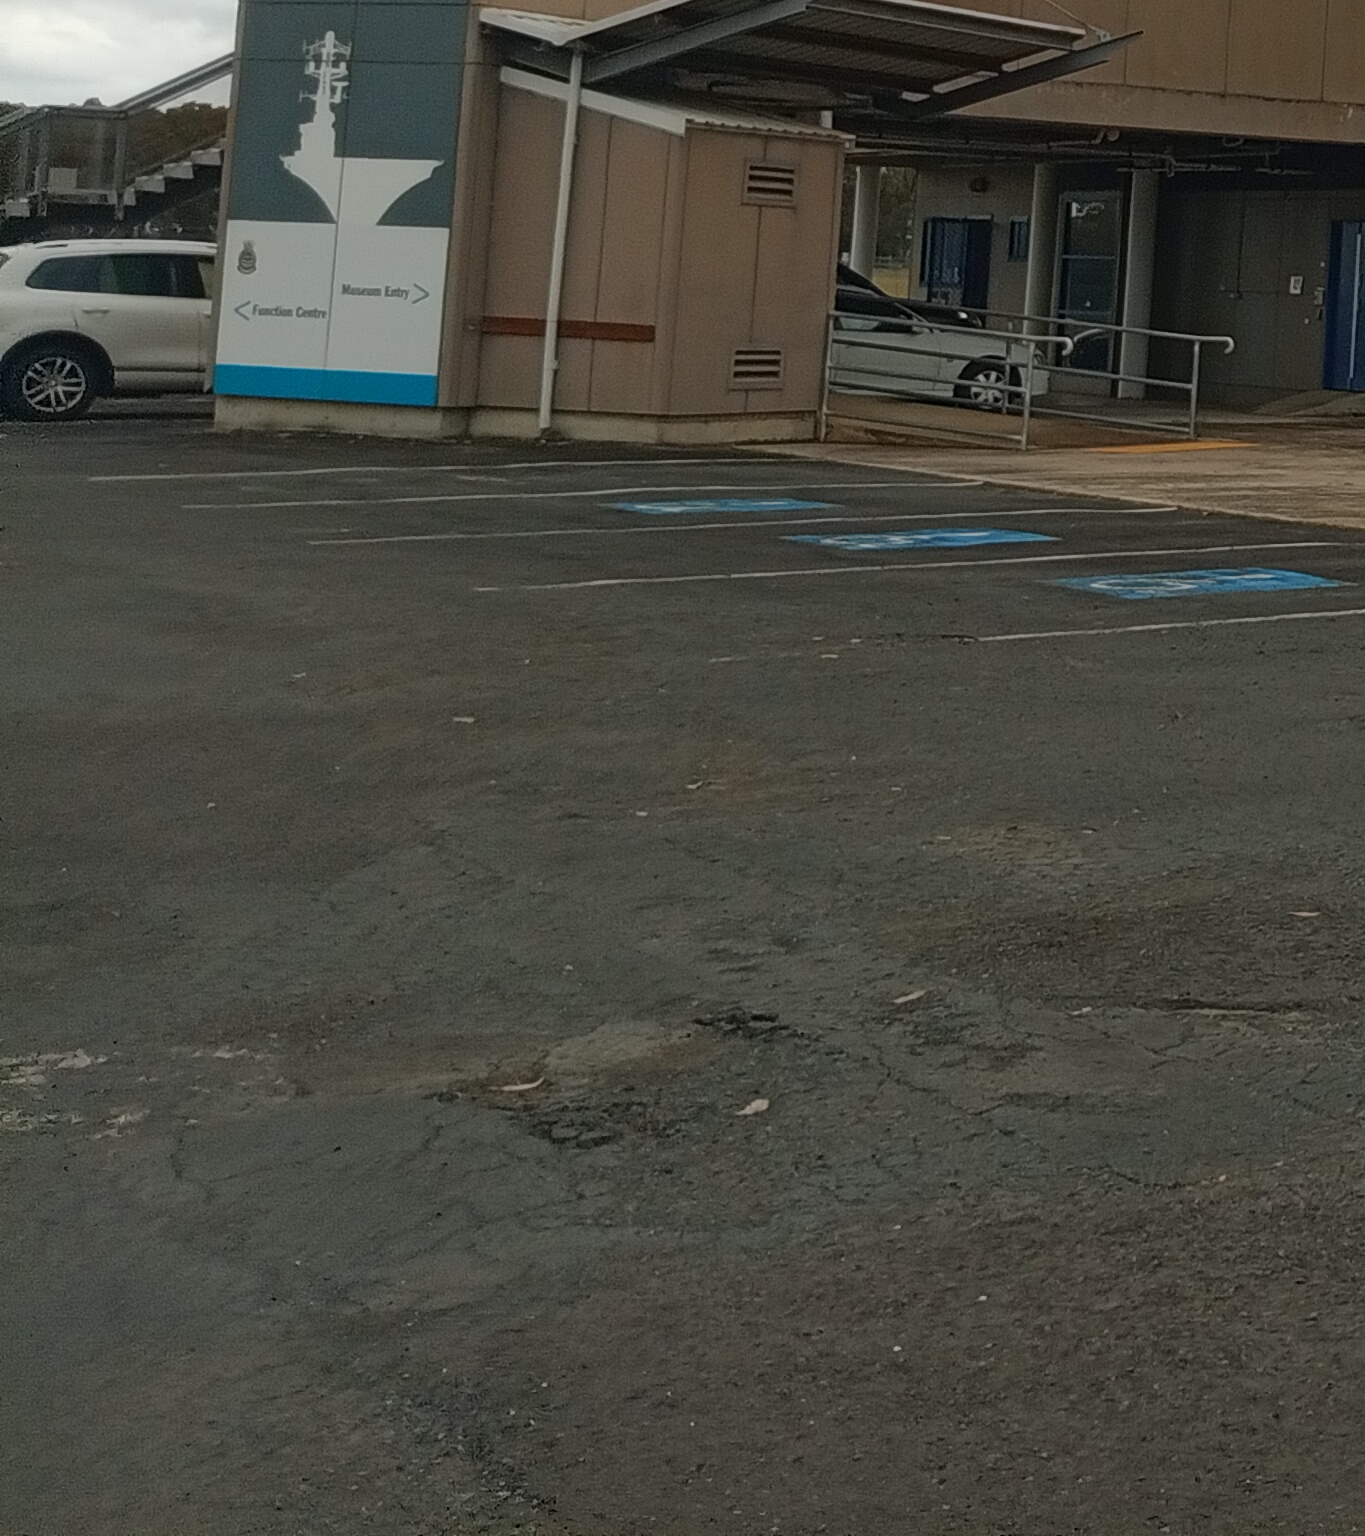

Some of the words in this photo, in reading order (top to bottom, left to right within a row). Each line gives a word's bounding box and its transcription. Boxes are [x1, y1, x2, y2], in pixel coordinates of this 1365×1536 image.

[341, 284, 382, 298] Museum
[384, 285, 411, 300] Entry
[252, 304, 294, 318] Function
[296, 306, 328, 319] Centre
